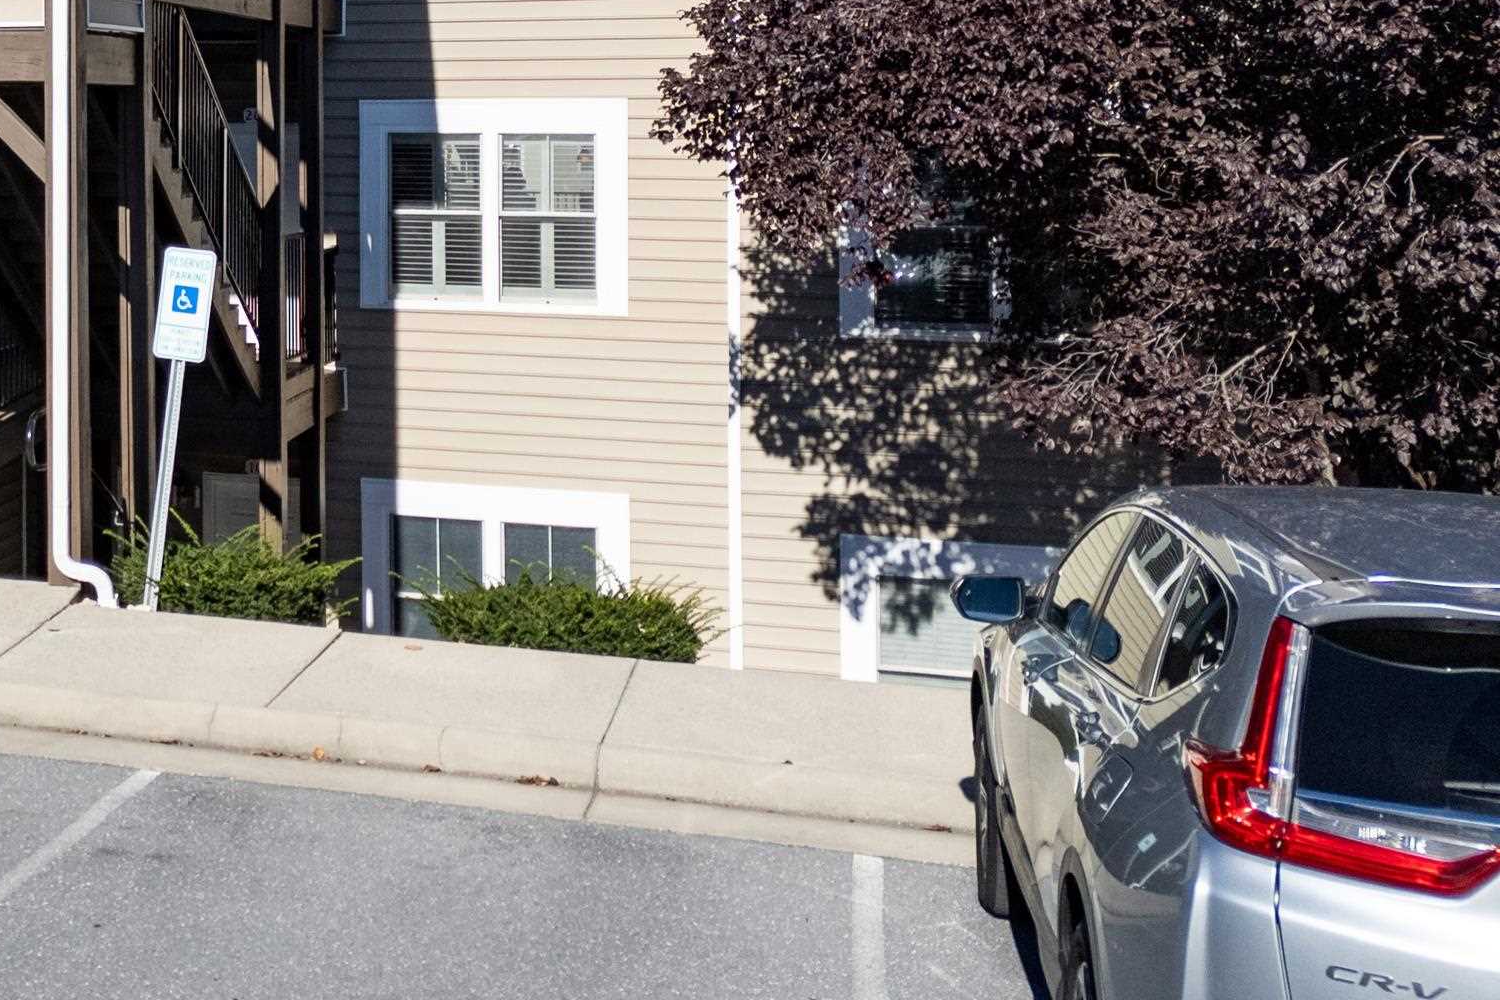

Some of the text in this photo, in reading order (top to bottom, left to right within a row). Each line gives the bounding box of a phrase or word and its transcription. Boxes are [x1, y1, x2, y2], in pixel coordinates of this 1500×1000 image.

[167, 255, 212, 269] RESERVED
[169, 270, 208, 283] PARKING
[1325, 965, 1448, 999] CR-V
